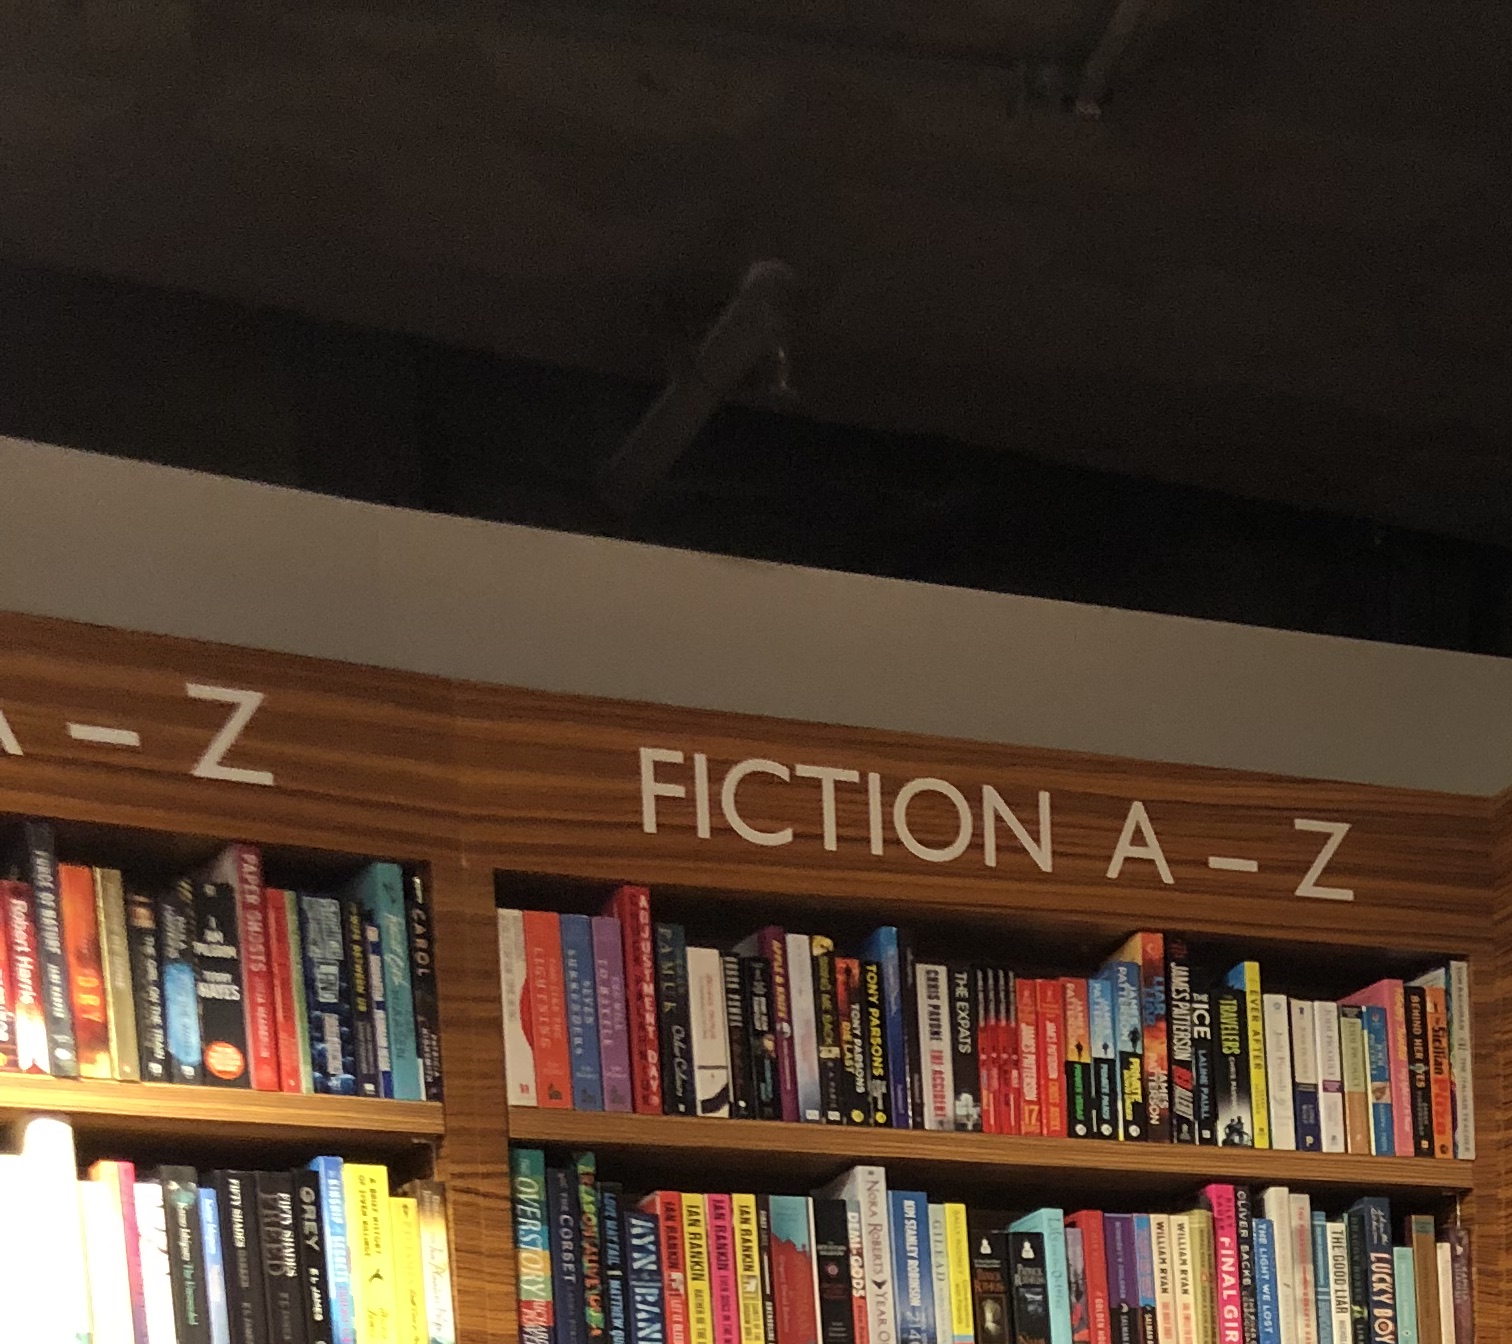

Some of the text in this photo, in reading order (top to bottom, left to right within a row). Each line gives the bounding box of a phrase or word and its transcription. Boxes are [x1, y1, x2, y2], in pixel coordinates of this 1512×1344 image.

[186, 683, 274, 785] Z
[639, 746, 1053, 872] FICTION
[1105, 800, 1174, 884] A
[1294, 818, 1354, 901] Z
[866, 965, 883, 1076] TONY PARSONS
[955, 972, 971, 1054] THE EXPATS
[1118, 966, 1130, 1040] PATTERSON
[1250, 990, 1263, 1070] EVER AFTER
[1158, 1071, 1168, 1108] JAMES
[278, 1193, 296, 1277] FIFTY SHADES
[516, 1176, 546, 1298] OVERSTORY
[739, 1205, 754, 1271] IAN RANKIN
[867, 1180, 880, 1217] NORA
[1237, 1191, 1251, 1285] OLIVER SACKS
[629, 1218, 657, 1270] AYN
[848, 1212, 865, 1297] DEMI-GODS
[868, 1223, 884, 1275] ROBERTS
[1156, 1221, 1169, 1294] WILLIAM RYAN
[1177, 1223, 1190, 1295] WILLIAM RYAN
[1220, 1237, 1238, 1298] FINAL
[1258, 1224, 1273, 1333] THE LIGHT WE LOST
[874, 1291, 888, 1326] YEAR
[1369, 1253, 1395, 1344] LUCKY BOY
